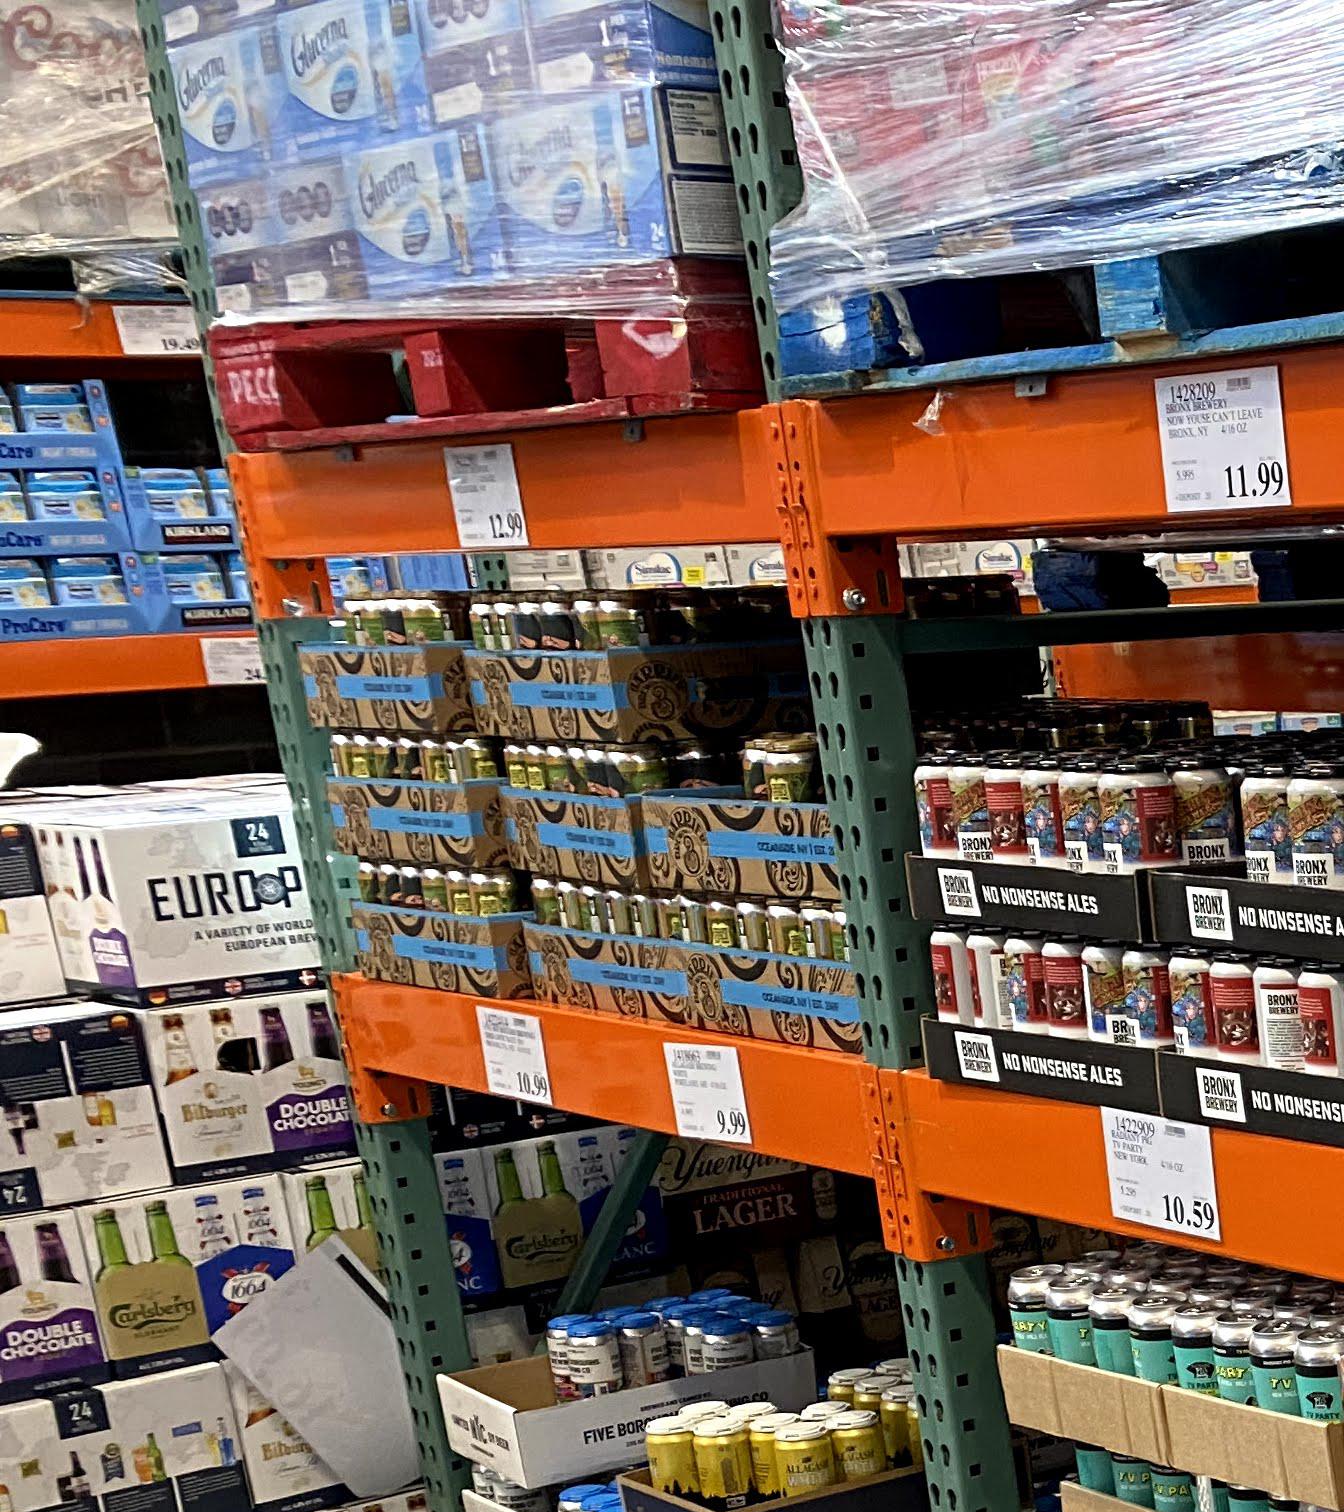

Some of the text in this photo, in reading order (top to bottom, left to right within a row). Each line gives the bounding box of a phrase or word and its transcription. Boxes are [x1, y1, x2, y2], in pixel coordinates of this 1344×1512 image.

[1171, 381, 1215, 403] 1428209
[1166, 399, 1228, 413] BRONX BREWERY
[1167, 408, 1262, 426] NOW YOUSE CAN'T LEAVE
[1200, 423, 1247, 436] NY OZ
[1225, 462, 1283, 498] 11.99
[165, 525, 229, 537] KIRKLAND
[489, 512, 522, 540] 12.99
[184, 608, 249, 619] KIRKLAND
[246, 823, 269, 841] 24
[943, 874, 971, 895] BRONX
[982, 885, 1098, 915] NO NONSENSE ALES
[1192, 892, 1225, 915] BRONX
[195, 919, 313, 940] A VARIETY OF WORLD
[1195, 914, 1226, 931] BREWERY
[1239, 907, 1256, 926] NO
[1258, 909, 1333, 933] NONSENSE
[225, 938, 287, 951] EUROPEAN
[1267, 993, 1298, 1006] BRONX
[961, 1039, 990, 1060] BRONX
[964, 1058, 992, 1073] BREWERY
[1002, 1052, 1123, 1087] NO NONSENSE ALES
[516, 1071, 548, 1098] 10.99
[1203, 1075, 1236, 1098] BRONX
[279, 1097, 348, 1119] DOUBLE
[1205, 1097, 1238, 1113] BREWERY
[1252, 1091, 1270, 1110] NO
[717, 1110, 746, 1136] 9.99
[1115, 1116, 1155, 1138] 1422909
[1123, 1142, 1143, 1153] PARTY
[692, 1194, 798, 1234] LAGER
[1162, 1195, 1214, 1230] 10.59
[230, 1280, 266, 1299] 1664
[109, 1295, 195, 1329] Carlsberg
[6, 1320, 82, 1346] DOUBLE
[1, 1332, 96, 1359] CHOCOLATE
[1270, 1378, 1292, 1389] TV
[69, 1401, 92, 1421] 24
[470, 1414, 487, 1444] NYC
[583, 1424, 616, 1444] FIVE
